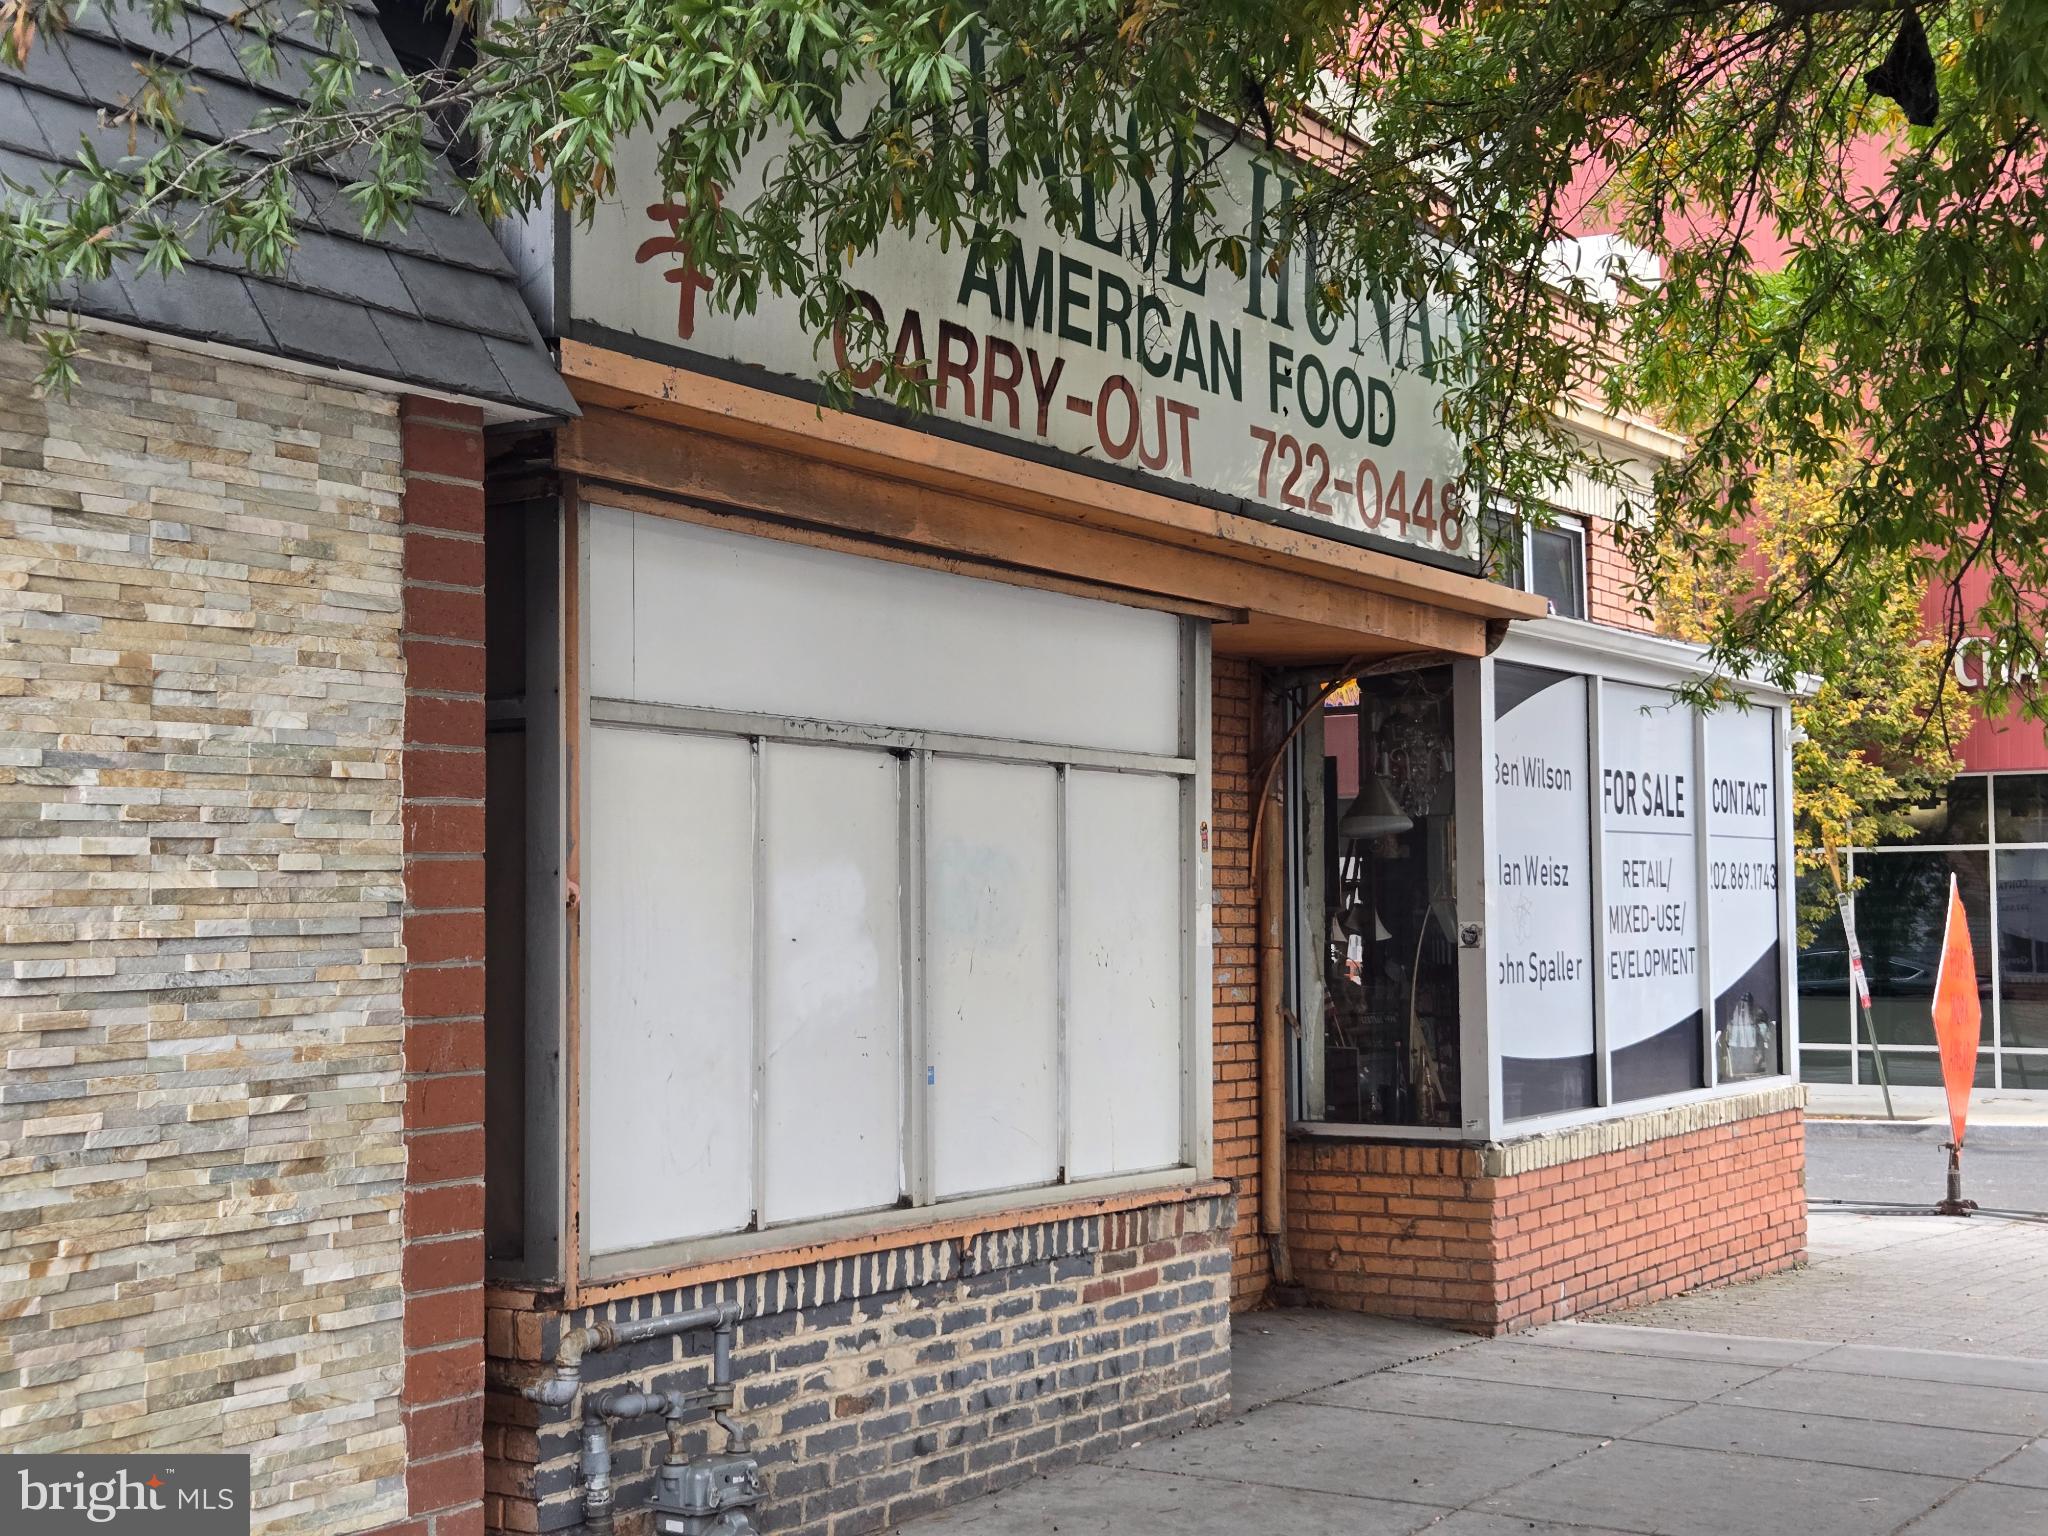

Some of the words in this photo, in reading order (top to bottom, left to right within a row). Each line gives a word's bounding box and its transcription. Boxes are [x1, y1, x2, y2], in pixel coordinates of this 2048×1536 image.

[957, 222, 1242, 401] AMERICAN
[1270, 342, 1395, 446] FOOD
[834, 290, 1199, 477] CARRY-OUT
[1250, 424, 1463, 549] 722-0448
[1523, 757, 1571, 790] Wilson
[1604, 769, 1637, 815] FOR
[1642, 772, 1684, 817] SALE
[1712, 778, 1767, 816] CONTACT
[1525, 856, 1568, 886] Weisz
[1622, 858, 1672, 892] RETAIL/
[1711, 862, 1776, 890] 02.869.1743
[1609, 901, 1686, 935] MIXED-USE/
[1529, 951, 1582, 990] Spaller
[1608, 948, 1695, 979] EVELOPMENT
